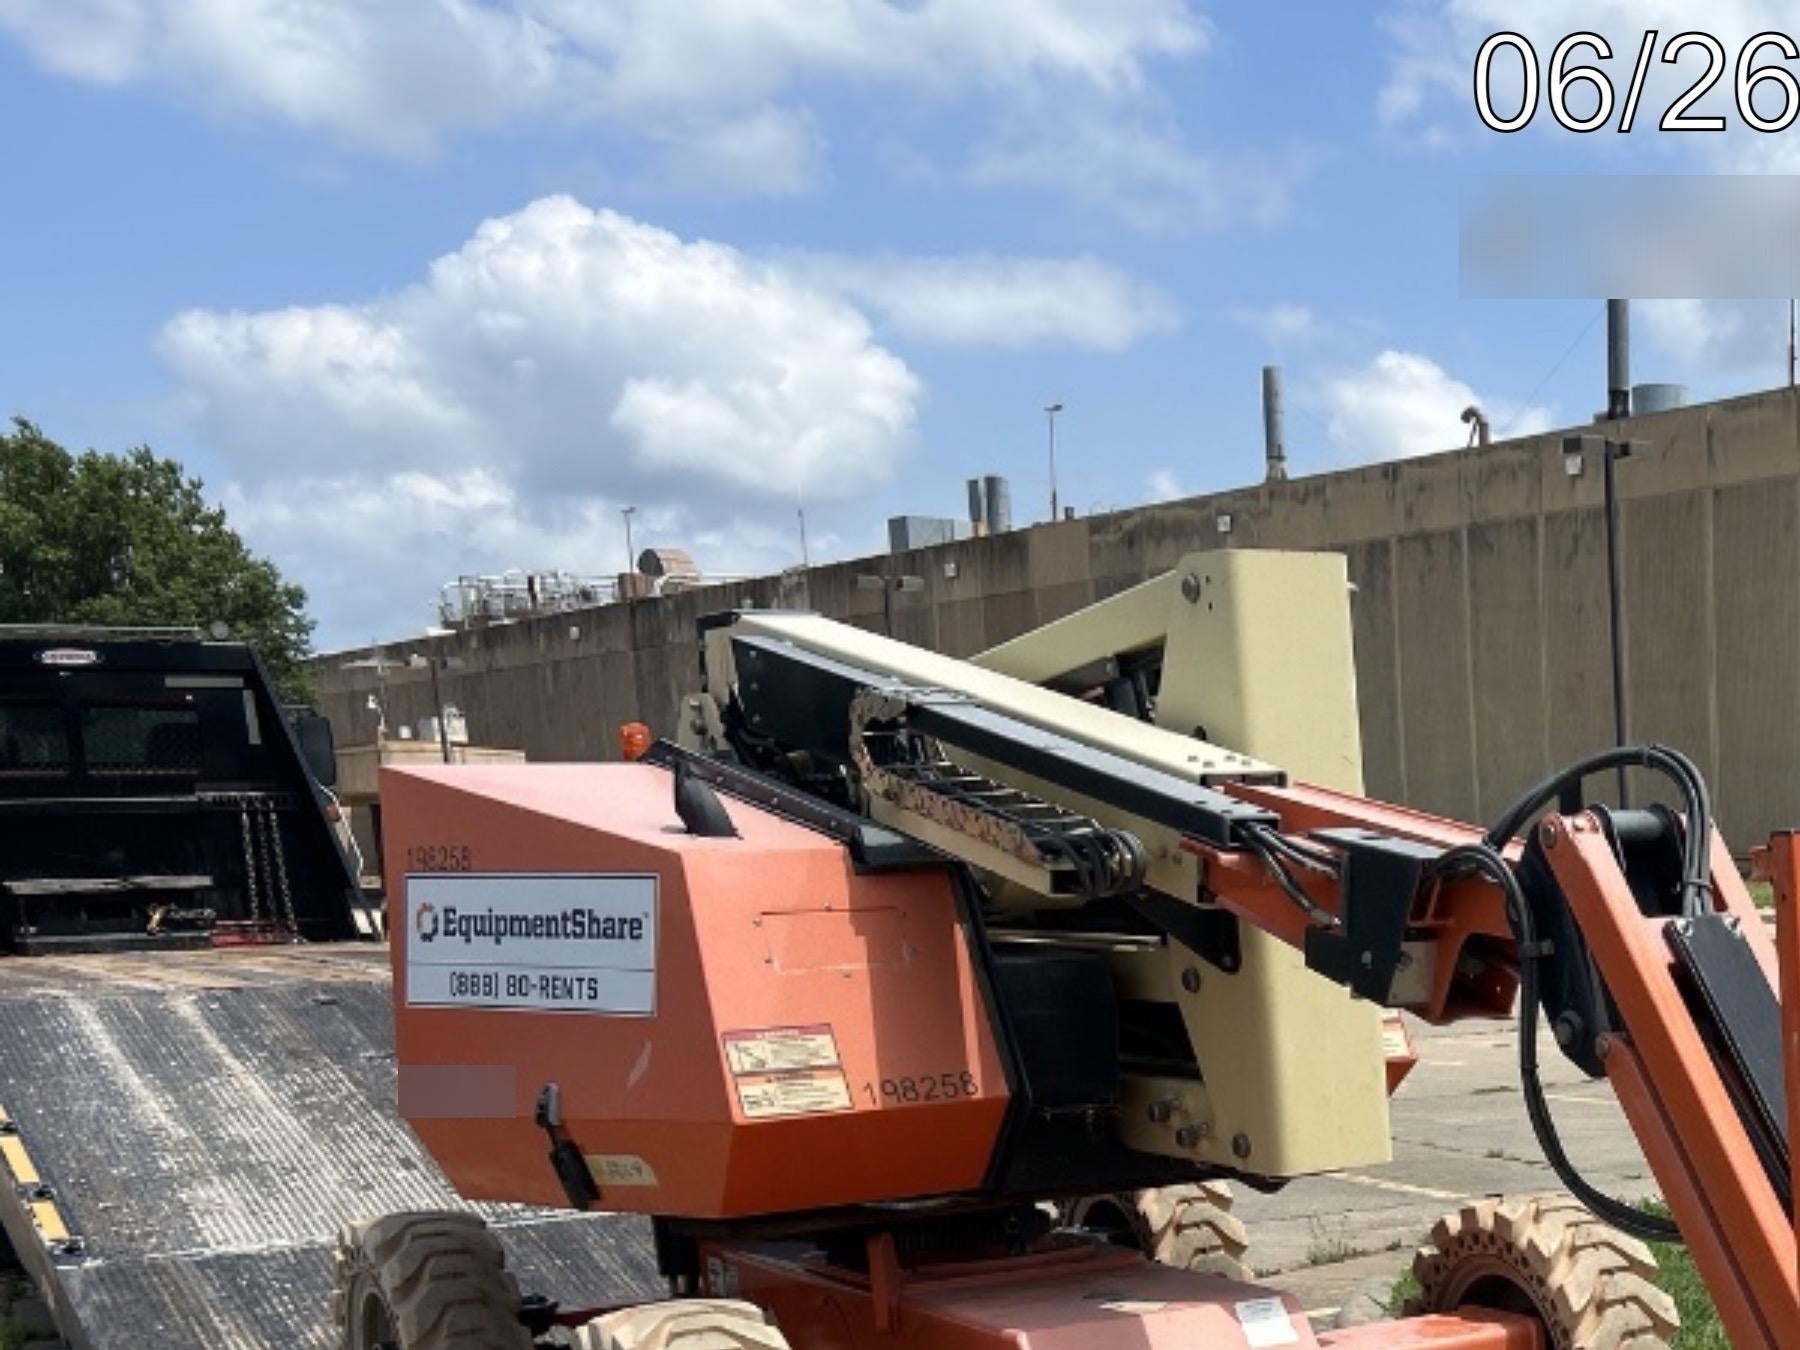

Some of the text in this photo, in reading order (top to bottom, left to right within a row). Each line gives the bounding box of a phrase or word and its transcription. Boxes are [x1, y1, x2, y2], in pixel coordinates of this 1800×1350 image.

[442, 906, 643, 945] EquipmentShare
[506, 973, 599, 1001] 80-RENTS
[863, 1071, 979, 1107] 198258
